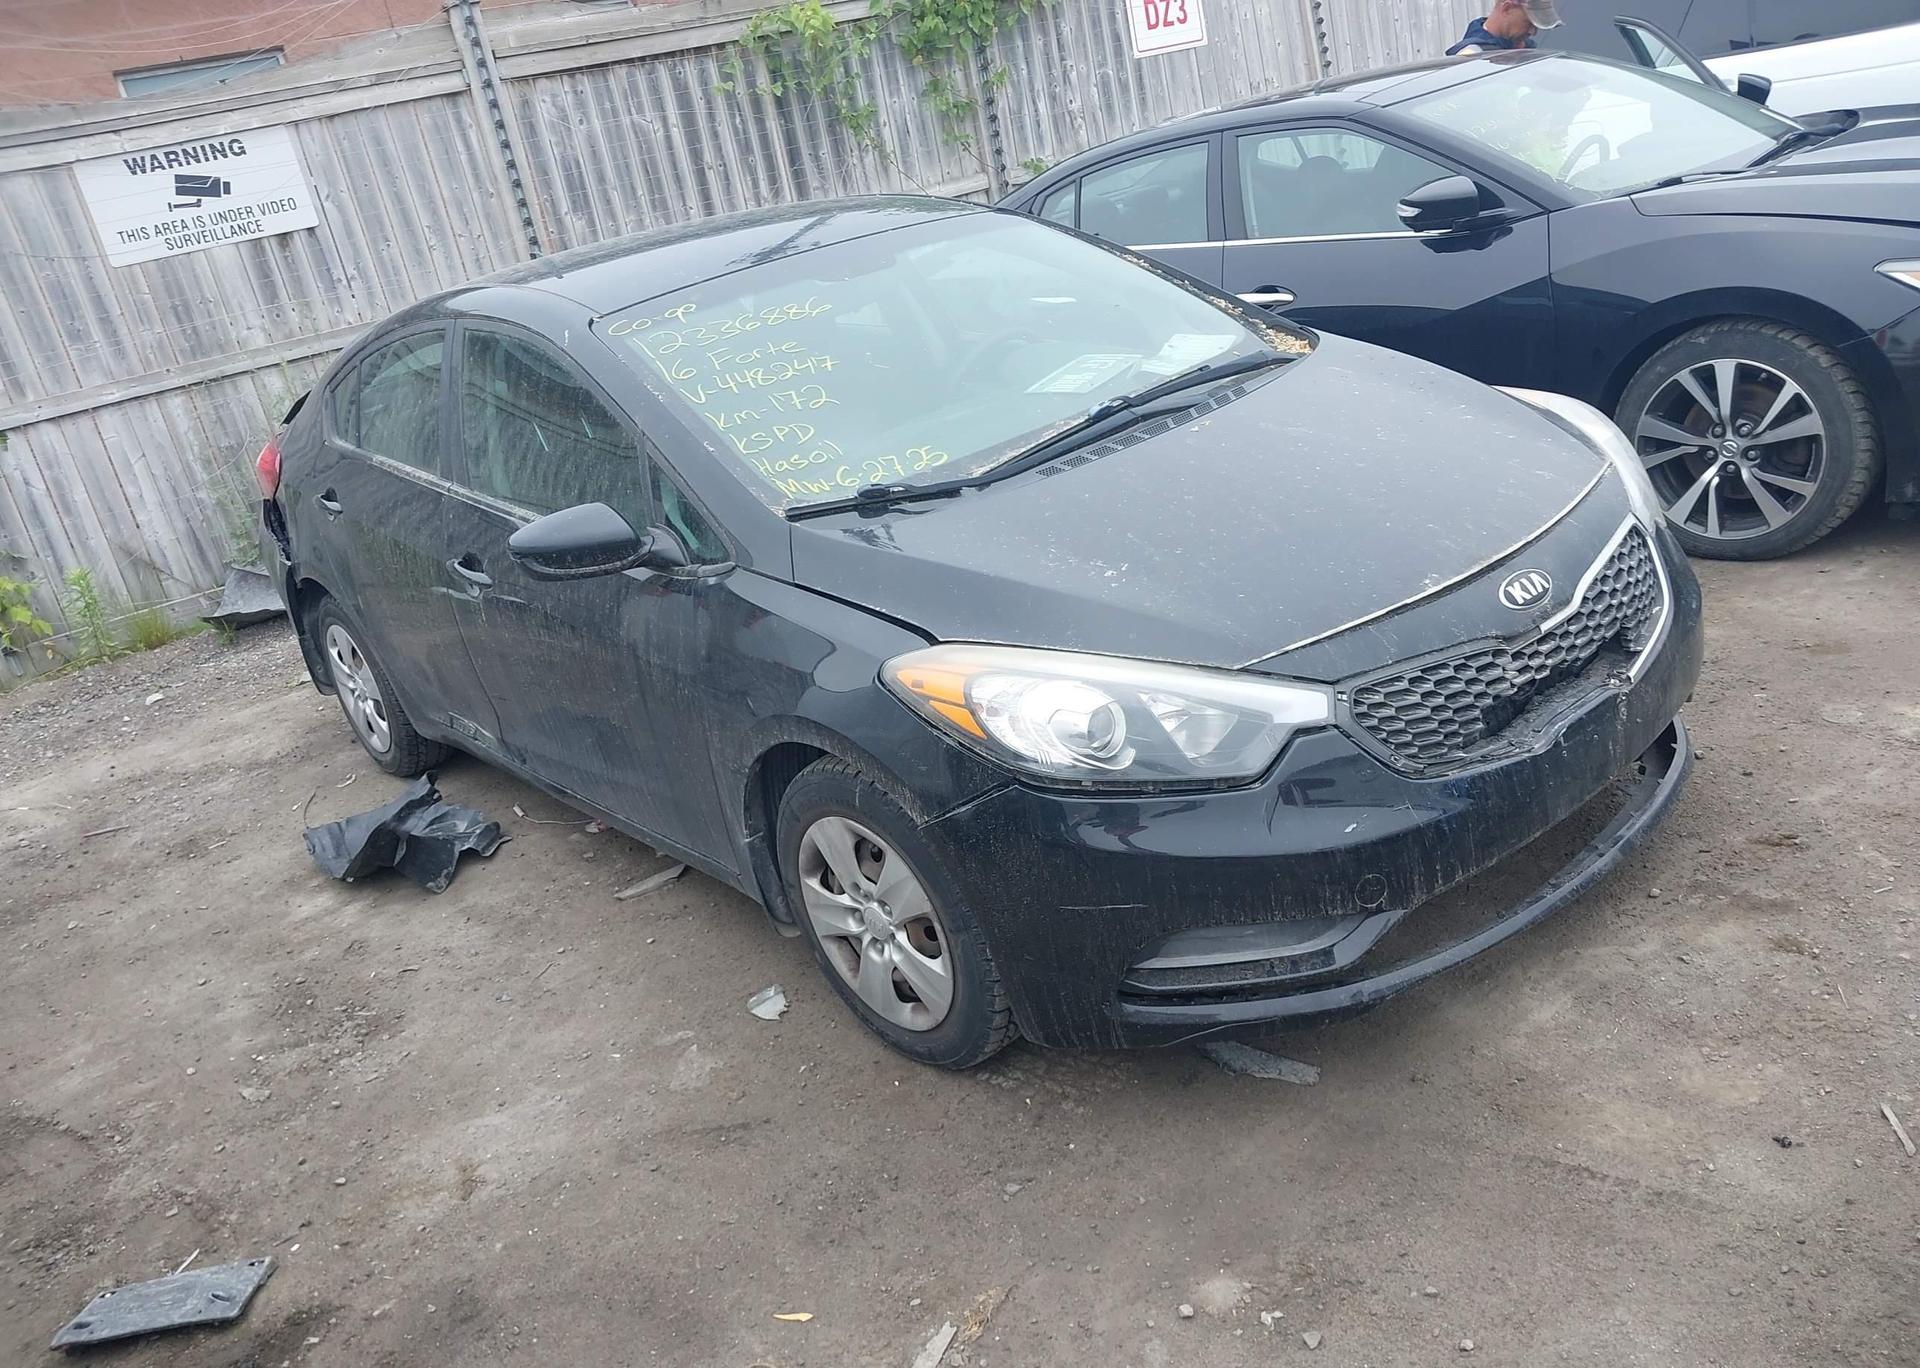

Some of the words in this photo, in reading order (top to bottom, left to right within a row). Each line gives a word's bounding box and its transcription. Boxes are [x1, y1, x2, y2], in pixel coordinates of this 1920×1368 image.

[1144, 0, 1188, 30] DZ3
[123, 138, 247, 175] WARNING
[117, 226, 150, 245] THIS
[154, 218, 190, 238] AREA
[193, 215, 206, 231] IS
[208, 206, 256, 226] UNDER
[257, 197, 297, 216] VIDEO
[164, 220, 265, 251] SURVEILLANCE
[655, 359, 697, 384] 16
[705, 340, 807, 370] Forte
[1505, 572, 1550, 605] KIA
